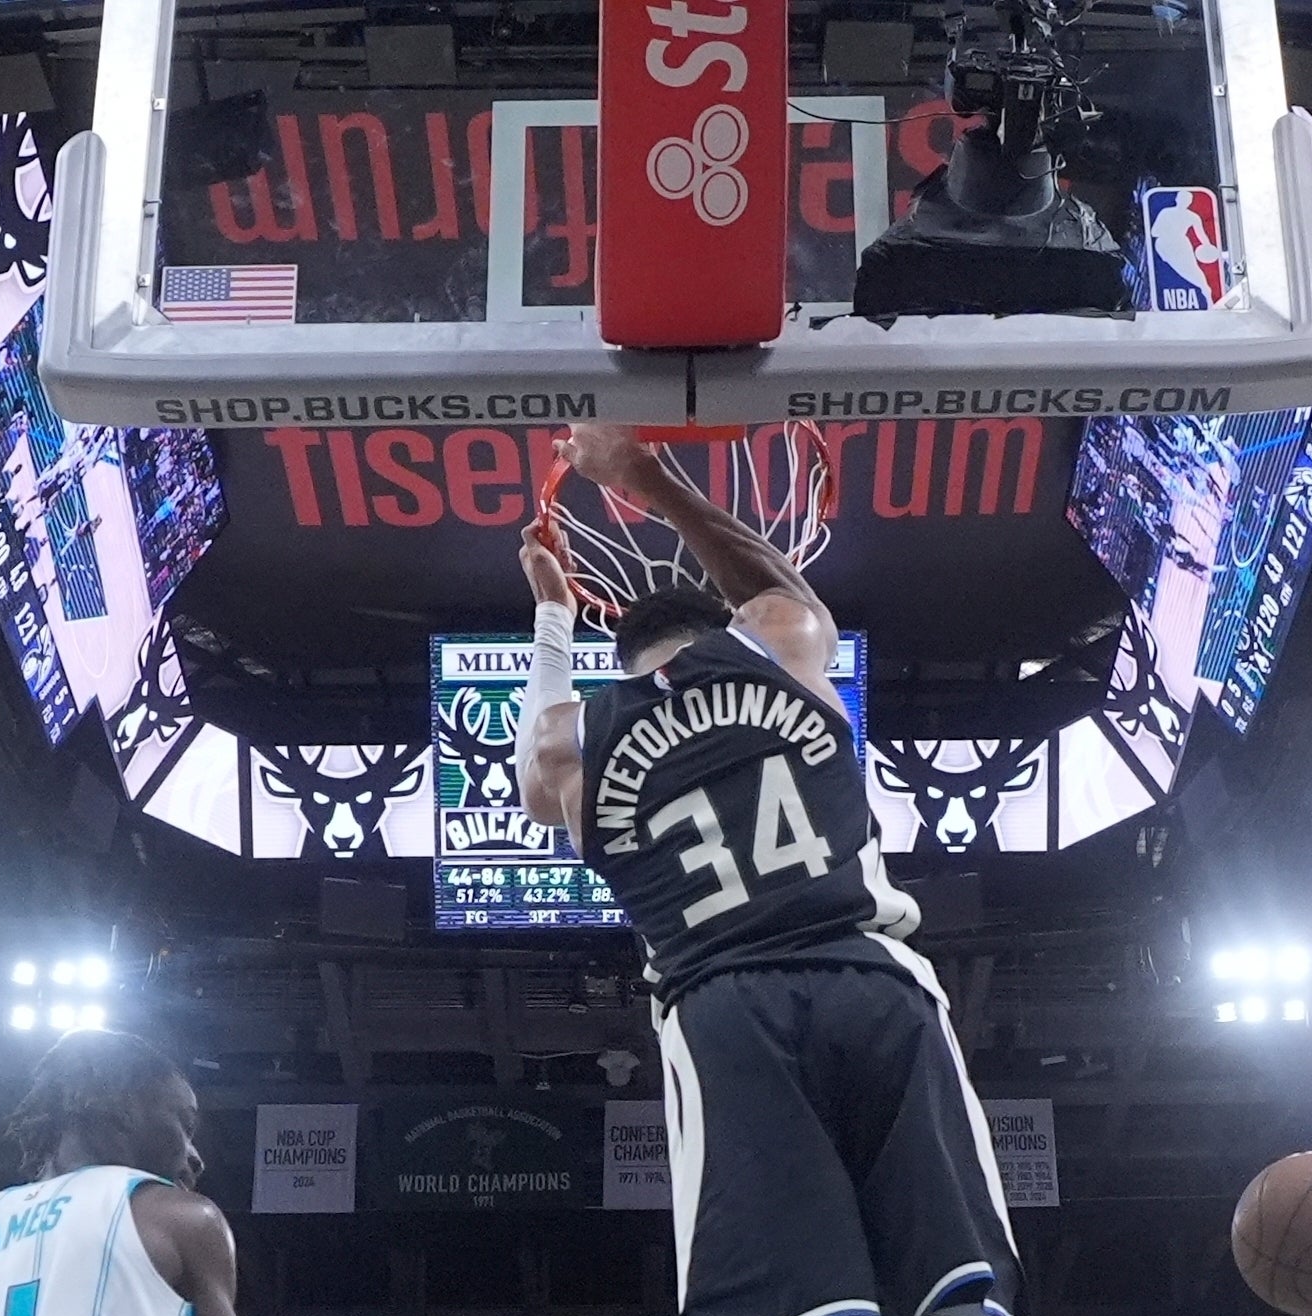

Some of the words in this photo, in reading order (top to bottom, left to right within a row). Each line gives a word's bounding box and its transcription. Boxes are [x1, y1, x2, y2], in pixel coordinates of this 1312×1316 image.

[1164, 288, 1199, 310] NBA
[156, 392, 597, 425] SHOP.BUCKS.COM
[787, 386, 1231, 417] SHOP.BUCKS.COM
[266, 424, 648, 528] fise
[1282, 513, 1308, 560] 121
[13, 601, 39, 645] 121
[1256, 594, 1281, 638] 120
[457, 651, 624, 673] MILWKE
[596, 681, 838, 856] ANTETOKOUNMPO
[446, 812, 546, 850] BUCKS
[647, 754, 833, 930] 34
[447, 867, 506, 886] 44-86
[517, 867, 573, 886] 16-37
[456, 887, 503, 904] 51.2%
[523, 887, 571, 903] 43.2%
[465, 910, 488, 925] FG
[528, 909, 561, 924] 3PT
[602, 908, 624, 924] FT
[610, 1125, 665, 1144] CONFER
[987, 1115, 1035, 1133] VISION
[276, 1129, 304, 1147] NBA
[308, 1129, 336, 1147] CUP
[991, 1133, 1048, 1152] MPIONS
[264, 1147, 347, 1166] CHAMPIONS
[614, 1144, 668, 1162] CHAMPI
[398, 1174, 460, 1194] WORLD
[467, 1171, 572, 1193] CHAMPIONS
